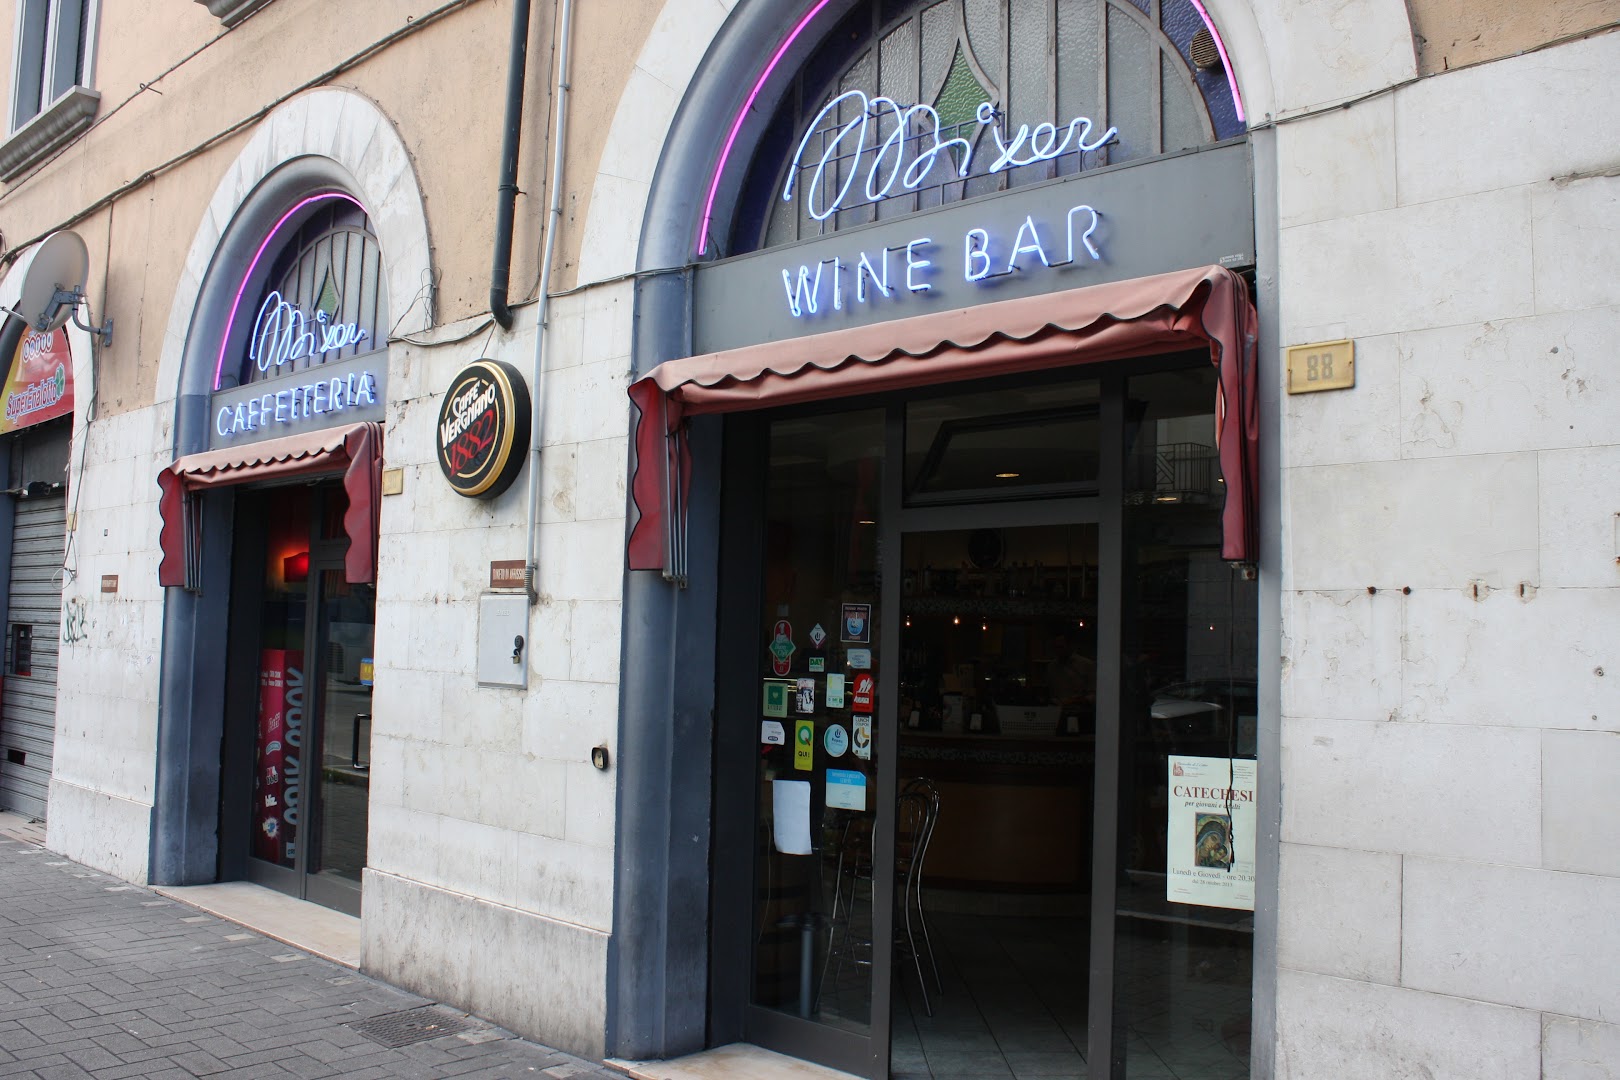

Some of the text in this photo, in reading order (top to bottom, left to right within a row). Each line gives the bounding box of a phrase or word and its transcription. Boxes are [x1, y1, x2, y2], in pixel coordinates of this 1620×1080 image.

[782, 204, 1100, 317] WINE BAR
[1306, 353, 1333, 381] 88
[217, 371, 374, 436] CAFFETTERIA
[449, 409, 495, 478] 1882
[810, 658, 823, 666] DAY
[1173, 785, 1254, 802] CATECHESI
[1195, 800, 1217, 808] giovani
